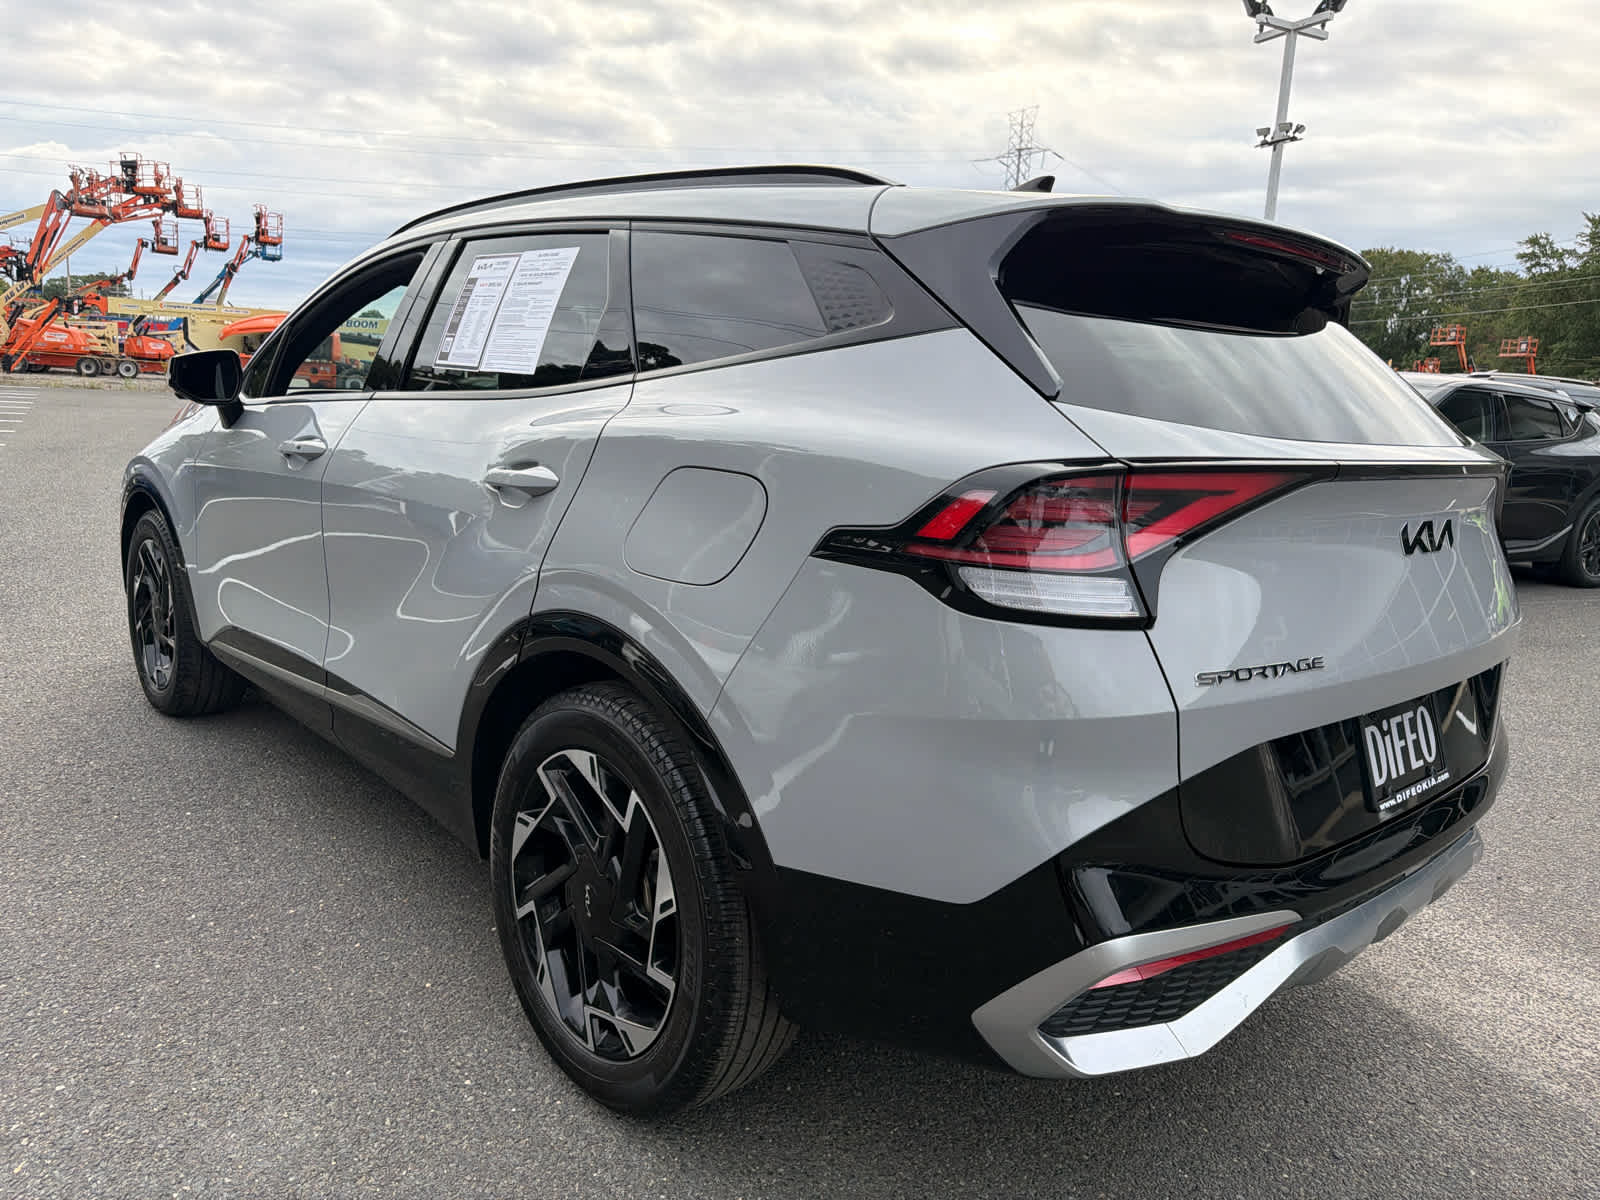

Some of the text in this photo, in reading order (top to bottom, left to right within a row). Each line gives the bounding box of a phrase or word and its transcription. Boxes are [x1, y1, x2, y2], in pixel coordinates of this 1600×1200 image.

[346, 320, 378, 329] BOOM
[1400, 519, 1454, 556] KIA
[1194, 656, 1325, 688] SPORTAGE
[1379, 772, 1450, 811] www.DIFEOKIA.com
